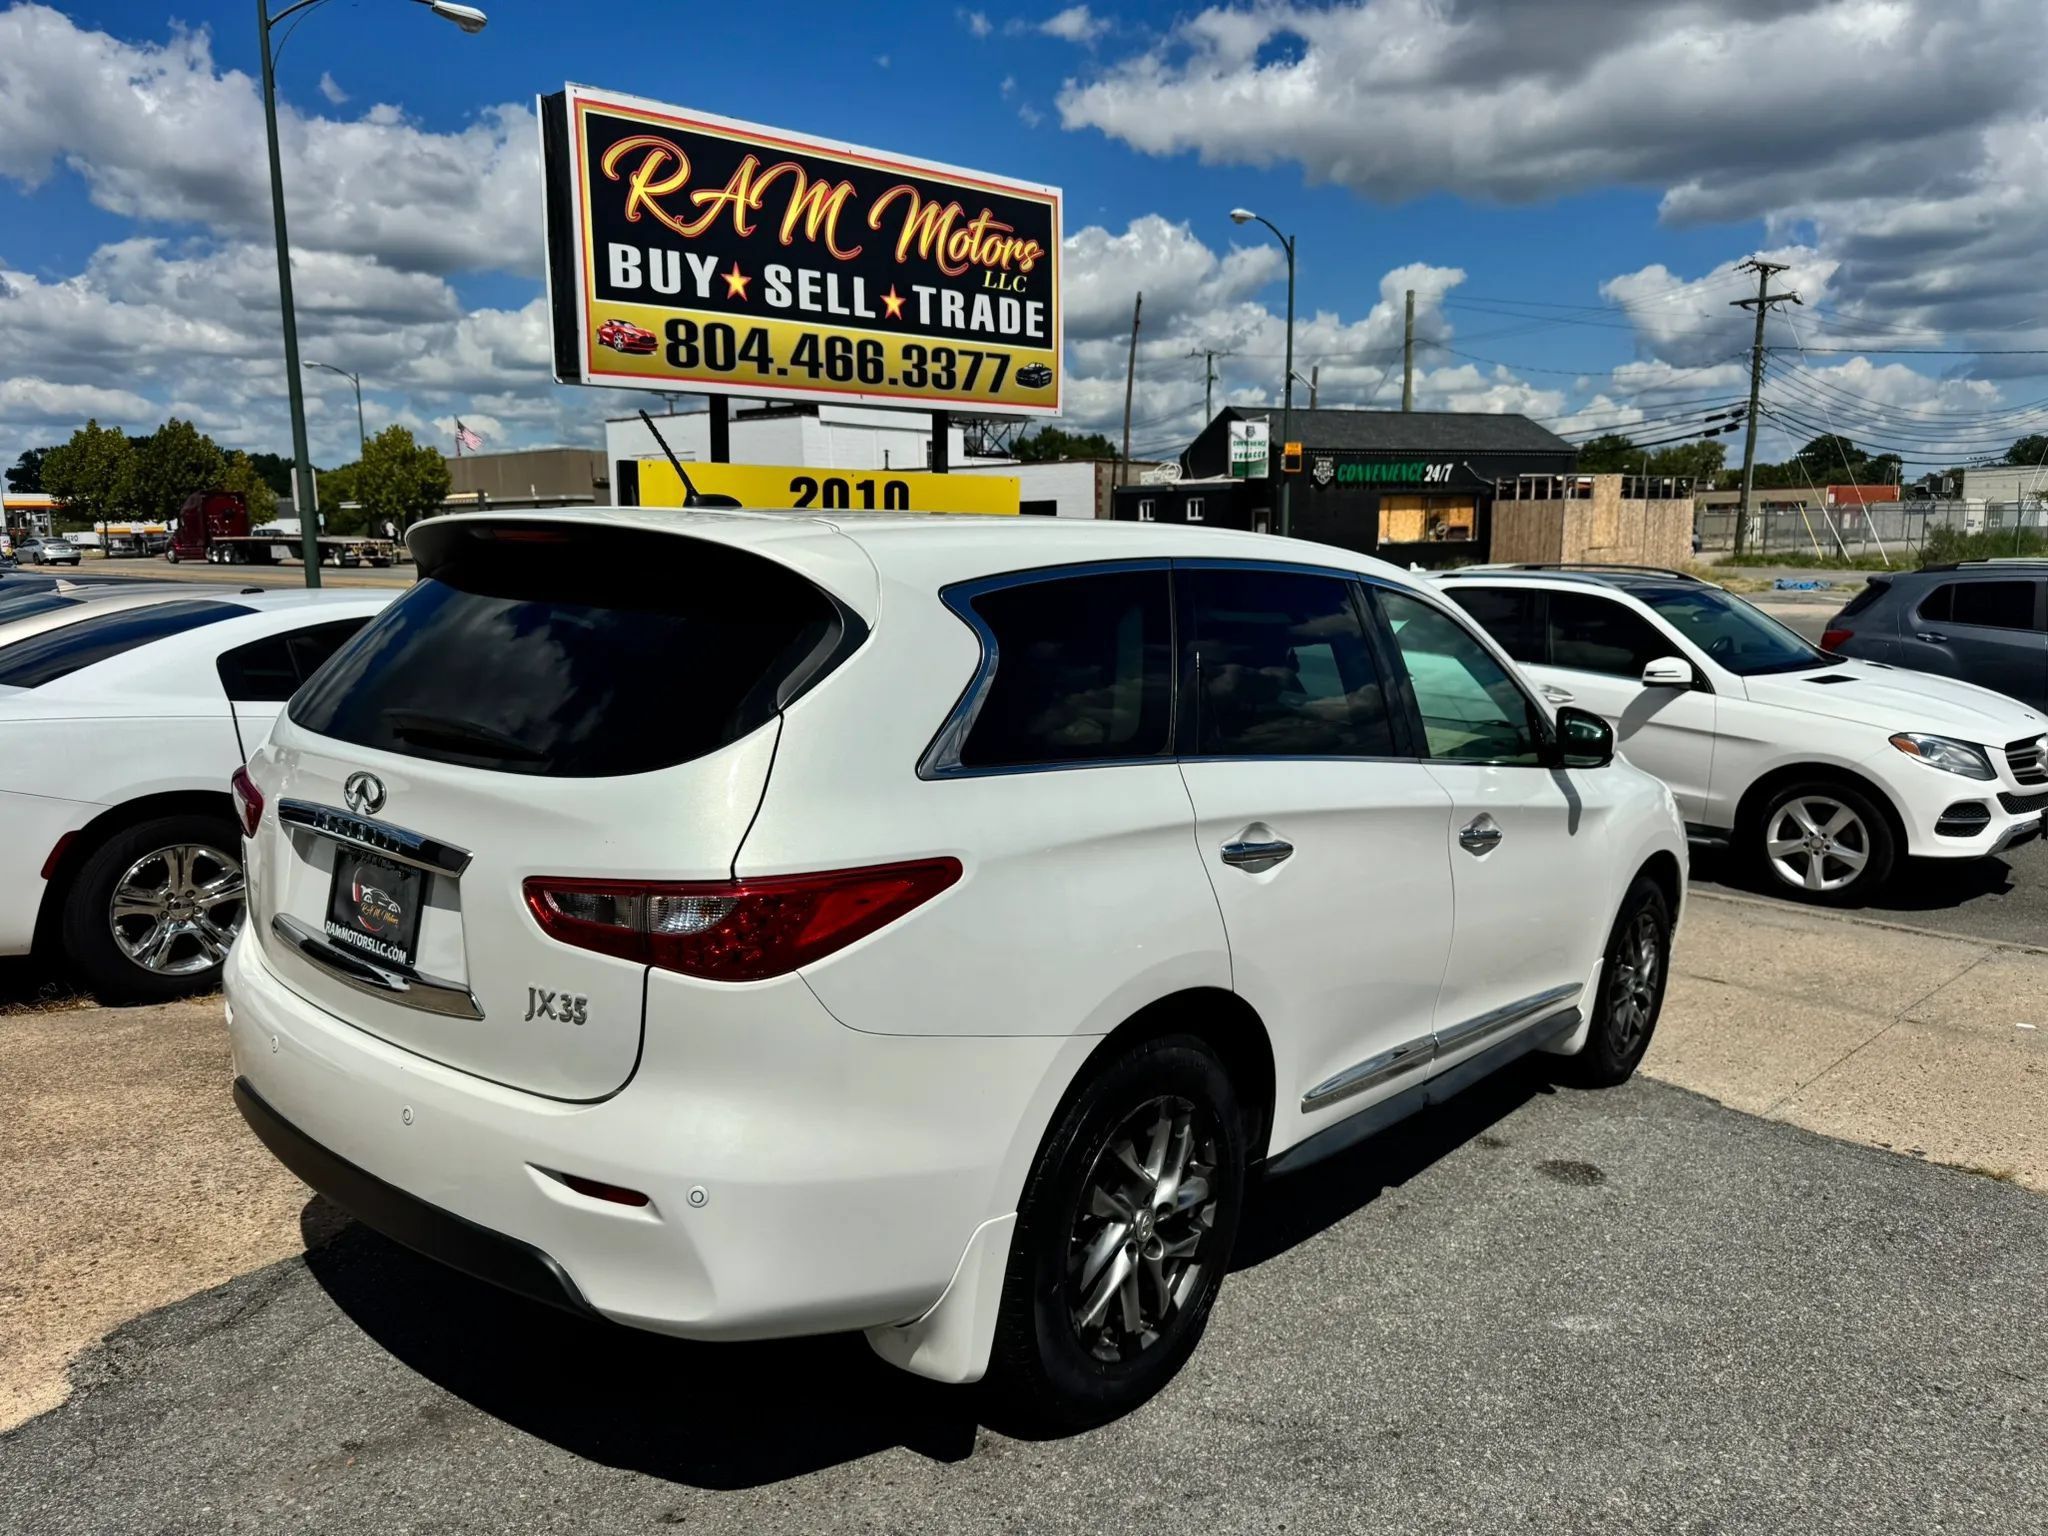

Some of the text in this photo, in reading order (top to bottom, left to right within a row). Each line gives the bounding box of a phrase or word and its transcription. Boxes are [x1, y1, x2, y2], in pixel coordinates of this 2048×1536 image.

[601, 135, 1045, 276] RAM Motors
[608, 242, 1044, 338] BUY SELL TRADE
[982, 271, 1028, 293] LLC
[665, 318, 1011, 393] 804.466.3377
[1337, 463, 1425, 482] CONVENIENCE
[1424, 463, 1454, 482] 24/7
[789, 476, 910, 511] 2010
[525, 986, 588, 1026] JX35
